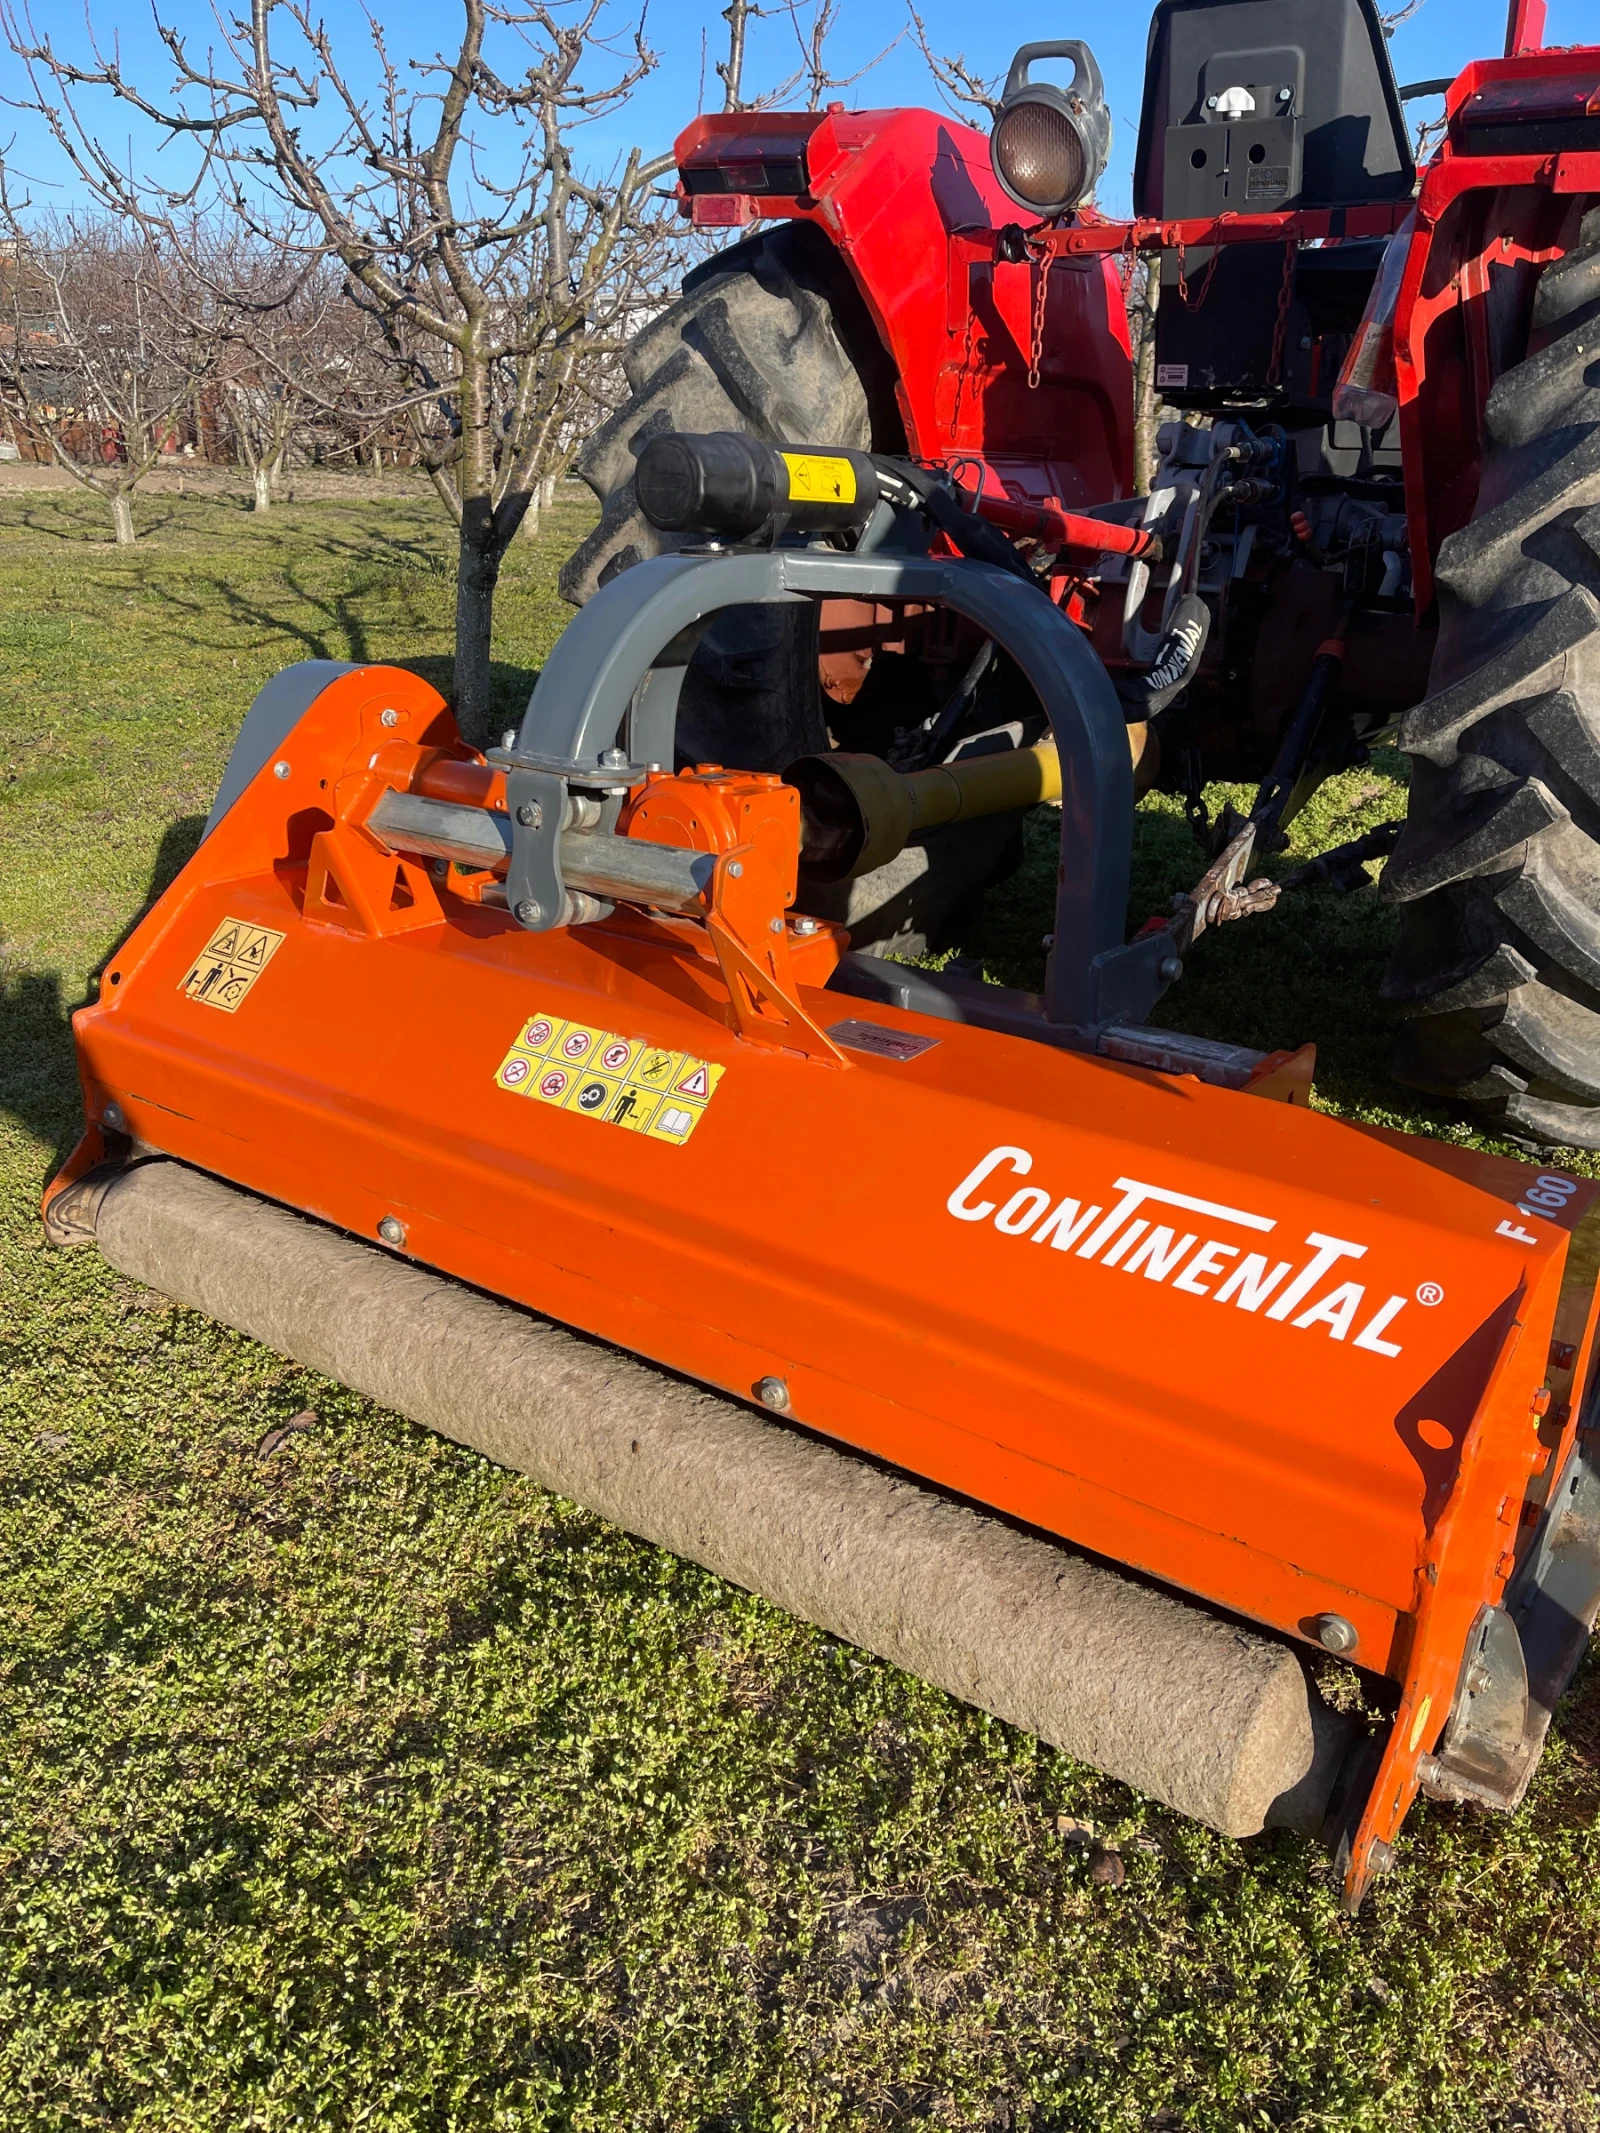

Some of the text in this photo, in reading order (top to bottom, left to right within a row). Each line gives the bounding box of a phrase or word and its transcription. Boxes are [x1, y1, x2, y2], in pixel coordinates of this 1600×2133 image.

[947, 1146, 1408, 1358] CONTINENTAL
[1495, 1175, 1577, 1245] F 160
